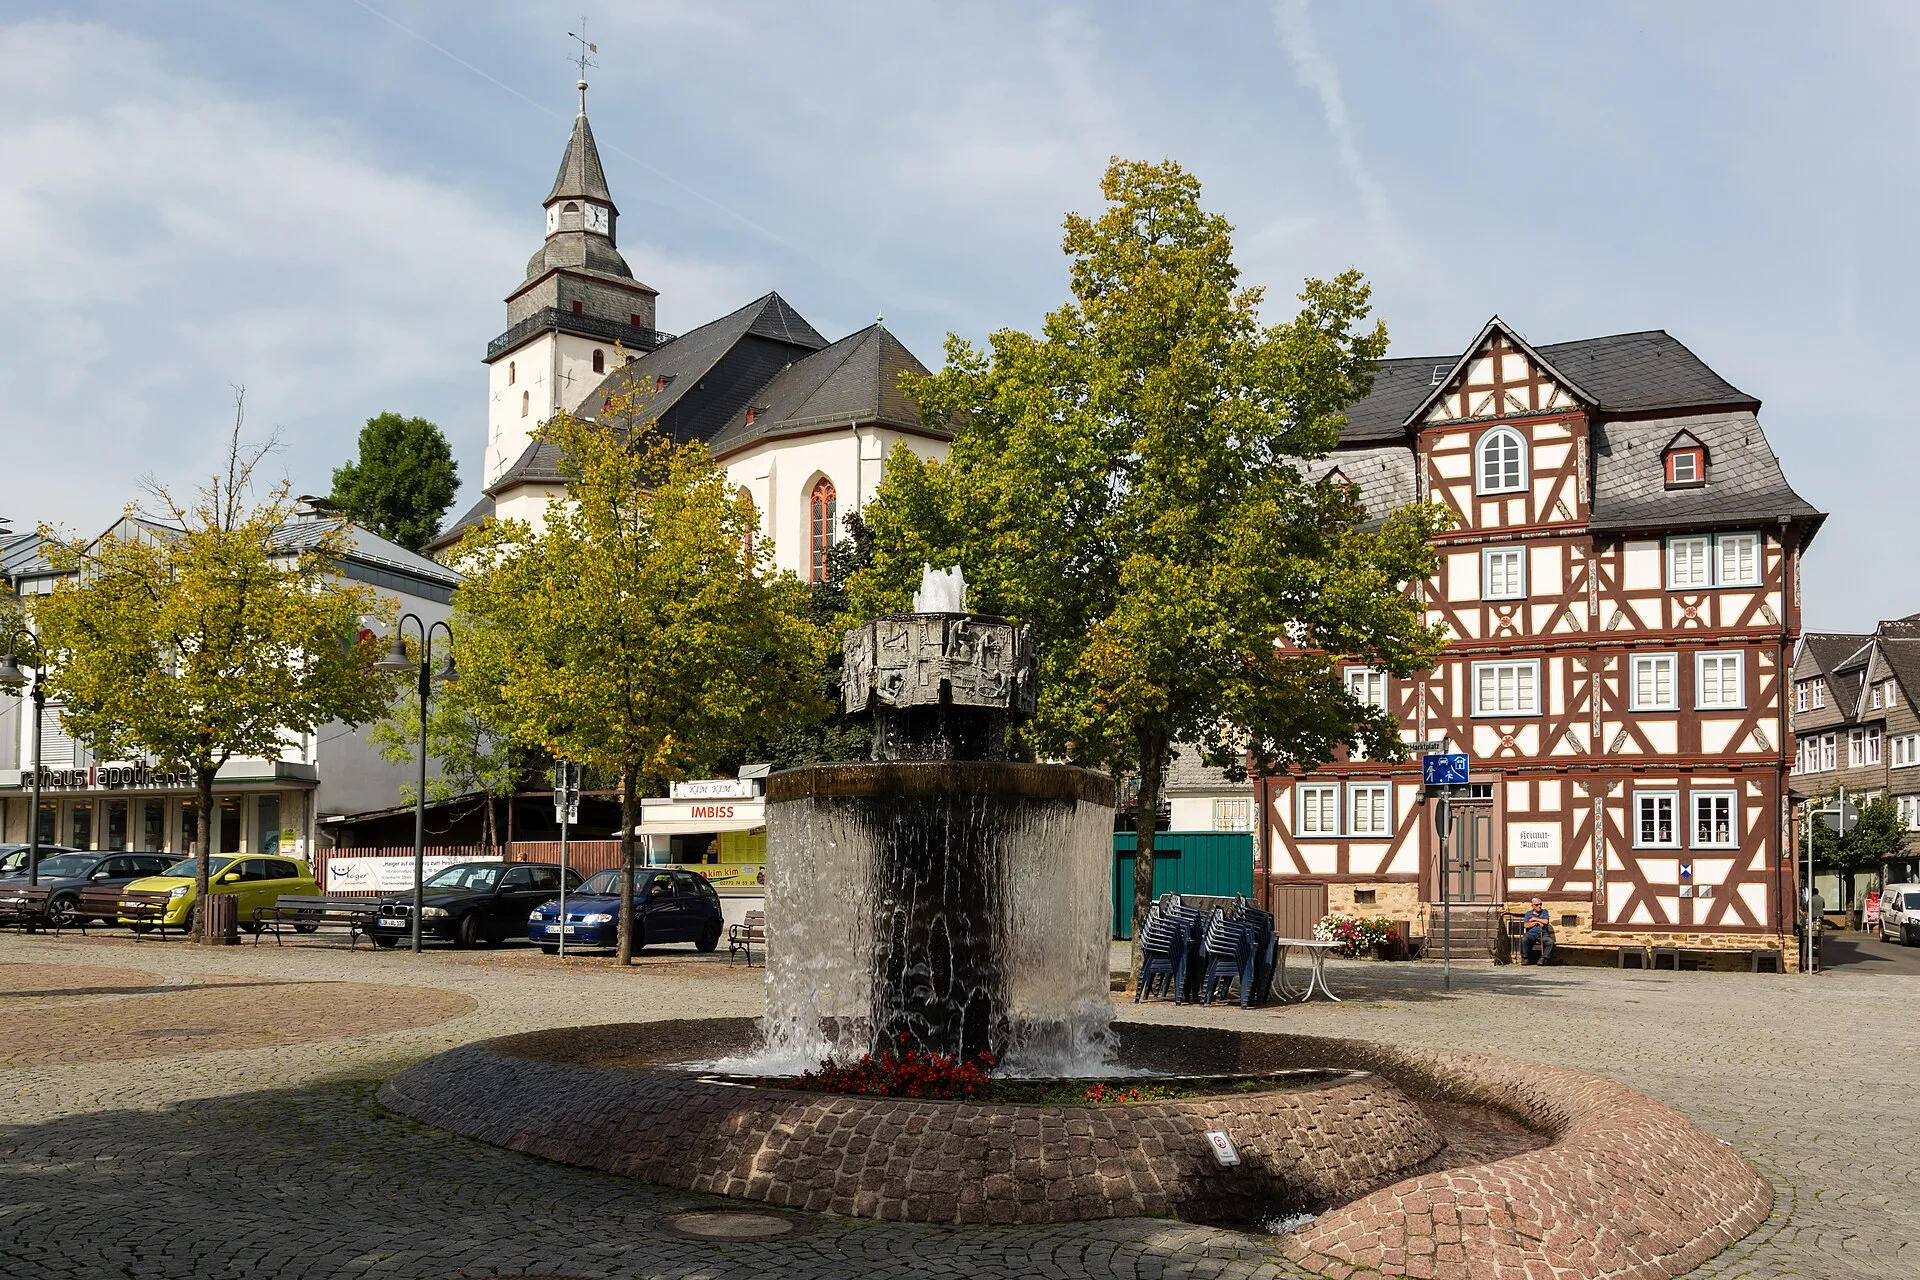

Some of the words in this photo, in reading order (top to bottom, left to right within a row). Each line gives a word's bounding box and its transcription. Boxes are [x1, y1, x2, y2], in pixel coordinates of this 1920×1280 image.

[1410, 742, 1440, 751] Marktplatz
[20, 765, 86, 788] rahaus
[689, 785, 708, 794] KIM
[712, 784, 732, 794] KIM
[691, 806, 734, 818] IMBISS
[725, 868, 739, 876] kim
